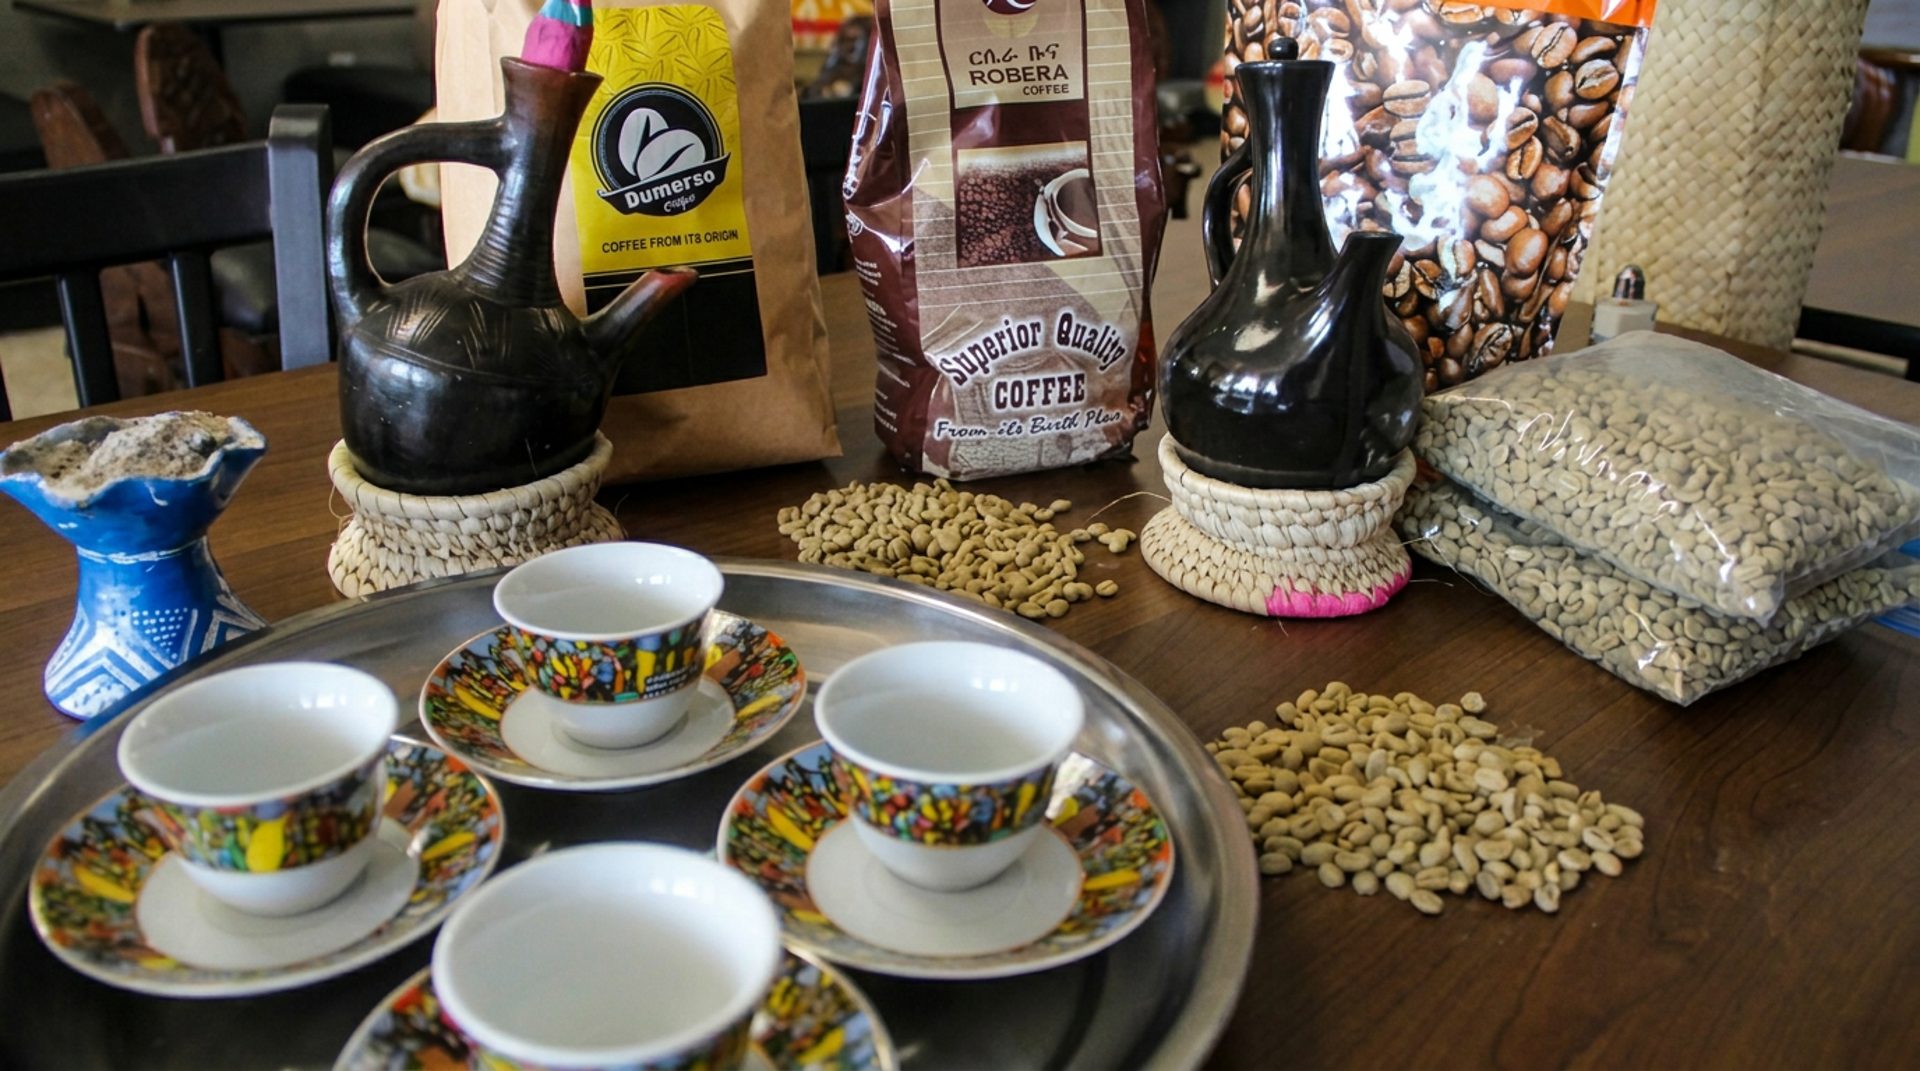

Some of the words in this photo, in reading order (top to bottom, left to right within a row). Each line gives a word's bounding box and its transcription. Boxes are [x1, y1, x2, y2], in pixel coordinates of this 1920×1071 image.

[968, 64, 1069, 86] ROBERA
[1022, 83, 1070, 96] COFFEE
[624, 170, 716, 209] Dumerso
[602, 238, 647, 254] COFFEE
[649, 234, 682, 249] FROM
[704, 229, 739, 244] ORIGIN
[939, 319, 1042, 387] Superior
[1056, 312, 1127, 372] Quality
[994, 373, 1086, 410] COFFEE
